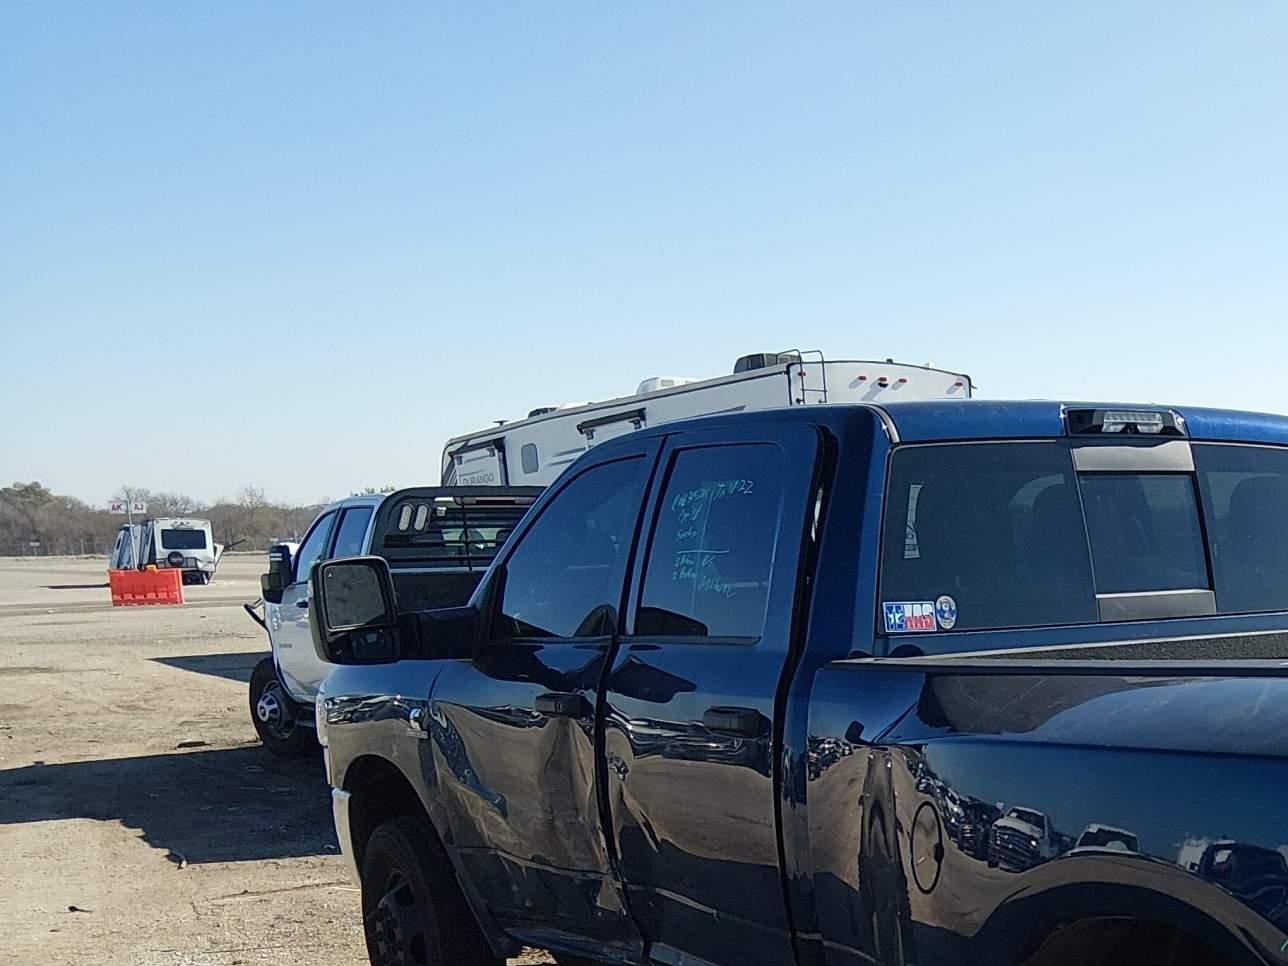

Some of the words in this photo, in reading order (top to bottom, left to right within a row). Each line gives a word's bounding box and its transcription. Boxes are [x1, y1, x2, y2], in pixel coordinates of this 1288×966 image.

[461, 472, 495, 486] DURANGO
[111, 503, 124, 512] AK
[885, 603, 934, 630] TEXAS
